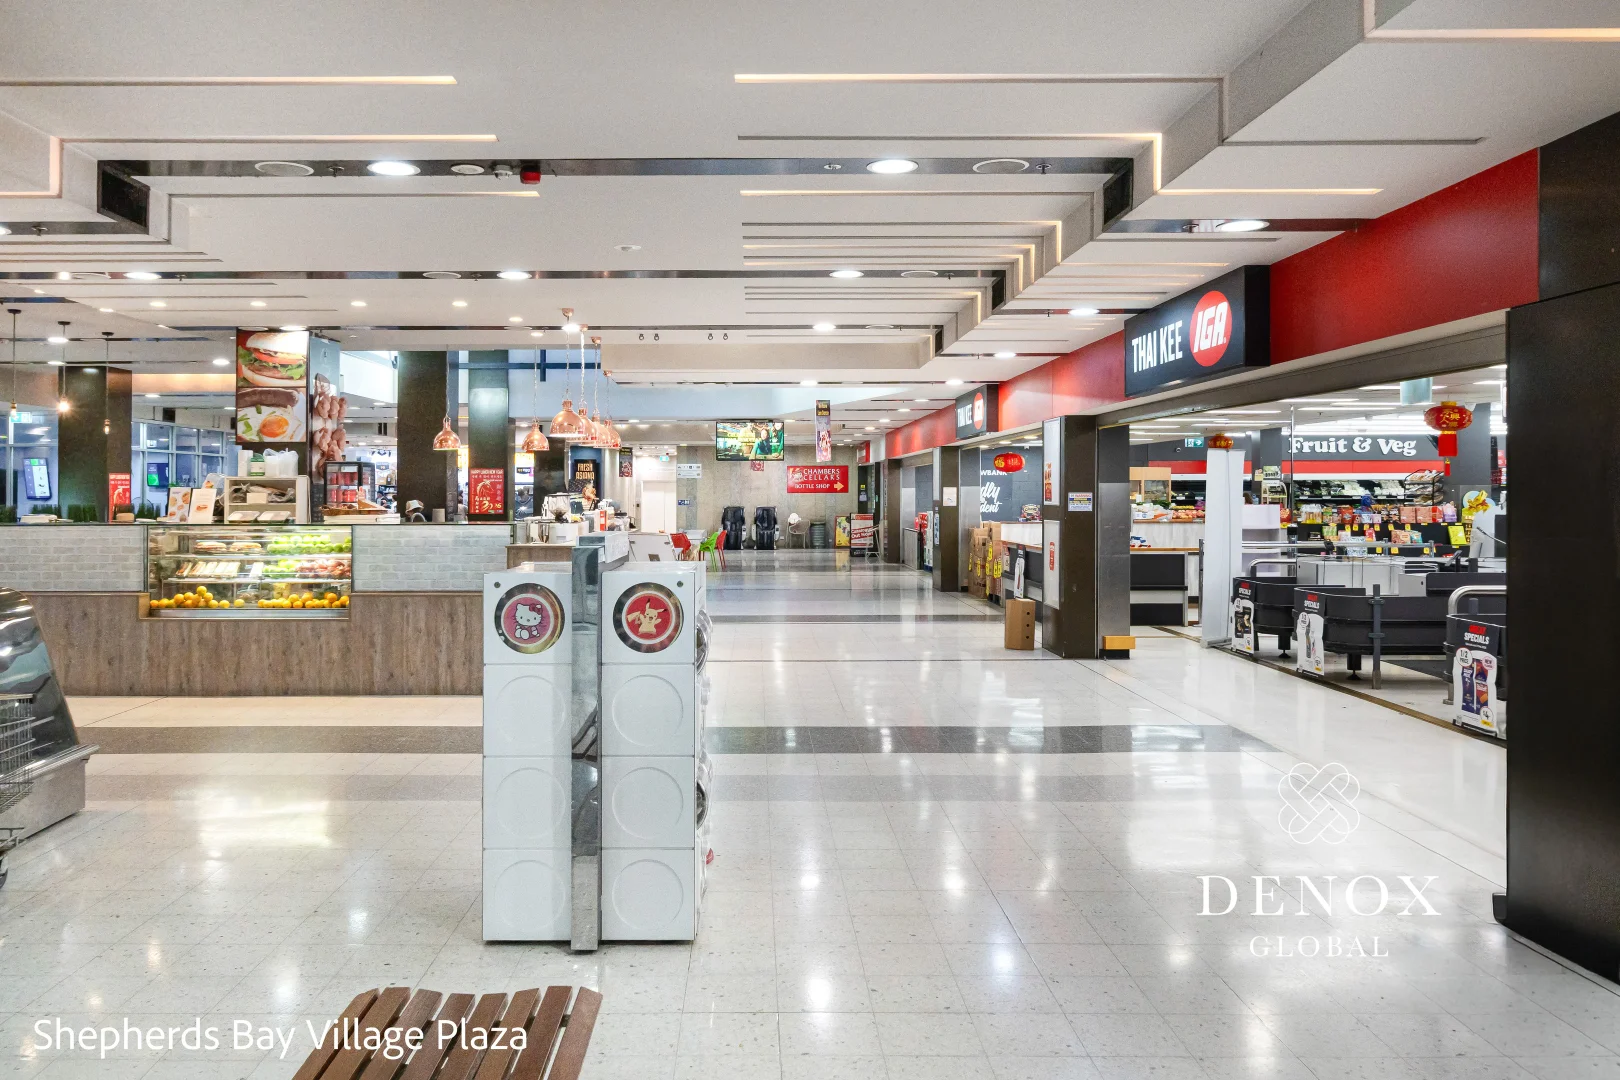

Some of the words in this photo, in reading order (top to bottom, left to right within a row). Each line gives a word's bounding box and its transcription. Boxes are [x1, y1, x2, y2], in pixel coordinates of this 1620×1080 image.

[1193, 301, 1229, 353] IGA
[1131, 331, 1157, 373] THAI
[1160, 320, 1183, 365] KEE
[1288, 437, 1347, 453] Fruit
[1352, 437, 1372, 453] &
[1377, 438, 1417, 456] Veg
[1464, 632, 1490, 645] SPECIALS
